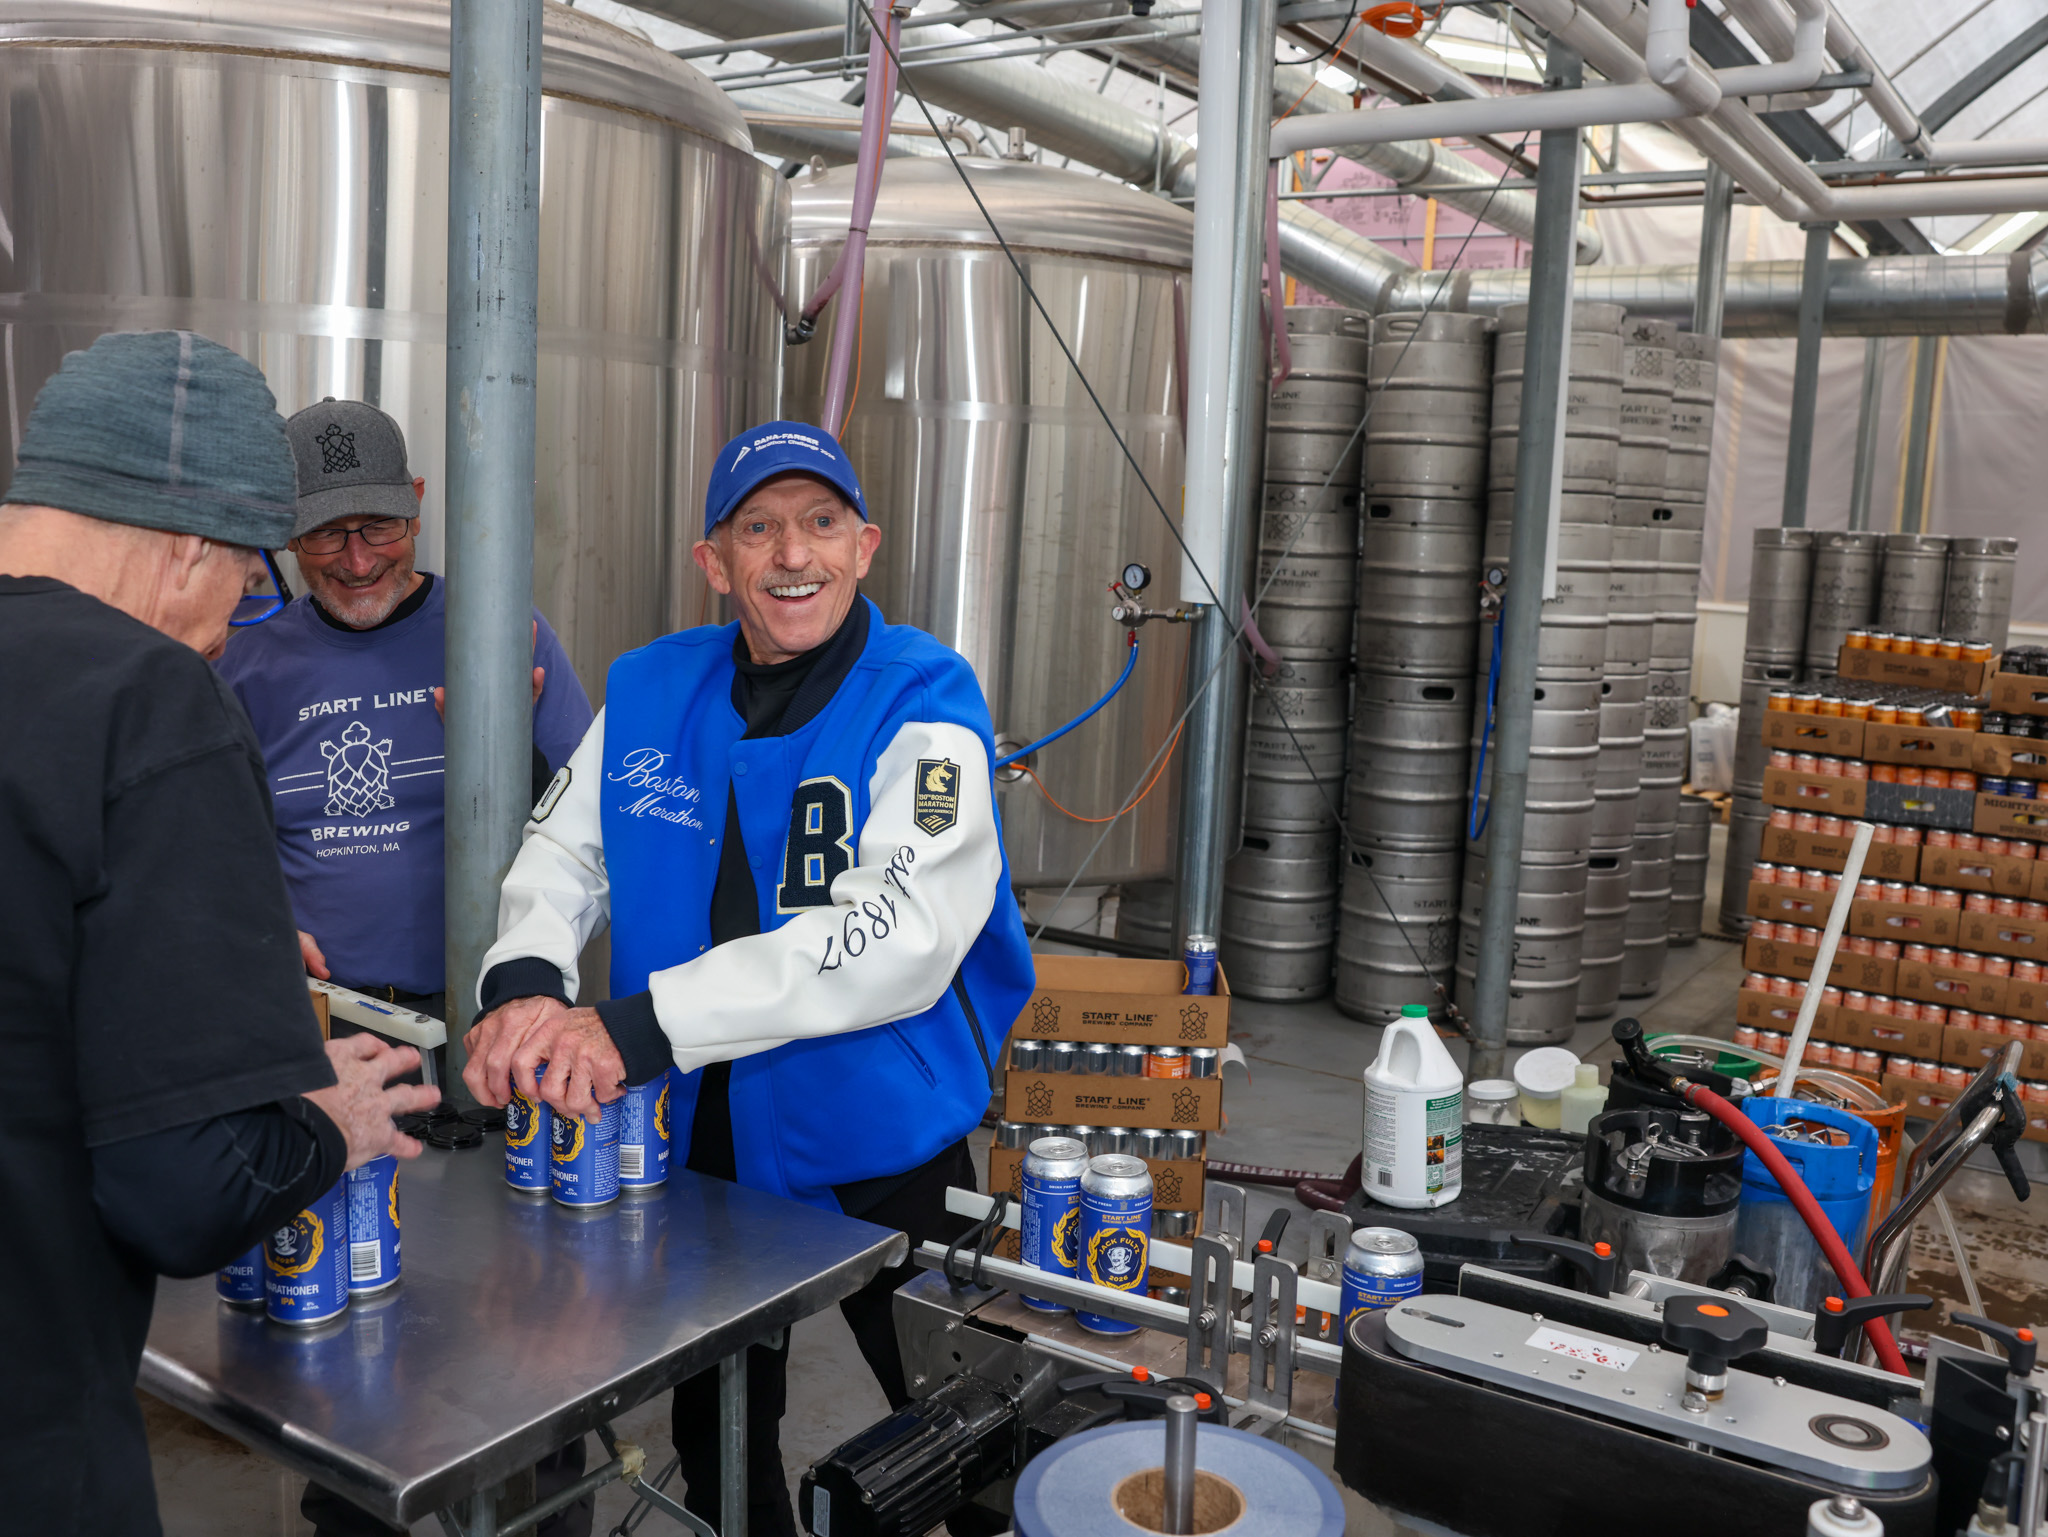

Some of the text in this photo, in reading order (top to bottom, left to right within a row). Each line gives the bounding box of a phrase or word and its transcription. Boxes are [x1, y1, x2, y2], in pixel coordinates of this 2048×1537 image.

[1620, 404, 1648, 414] TART
[754, 433, 819, 447] DANA-FARBER
[1260, 568, 1287, 577] TART
[298, 697, 362, 722] START
[608, 747, 701, 803] Boston
[918, 801, 954, 809] MARATHON
[1984, 798, 2029, 811] MIGHTY
[619, 792, 703, 831] Marathon
[311, 821, 410, 842] BREWING
[316, 842, 401, 859] HOPKINTON, MA
[776, 775, 854, 915] B
[818, 893, 898, 976] 1897
[1082, 1012, 1120, 1021] START
[1075, 1096, 1113, 1104] START
[508, 1164, 517, 1173] IPA
[553, 1179, 562, 1188] IPA
[1099, 1237, 1140, 1255] JACK FULTZ
[275, 1255, 296, 1264] 2026
[281, 1297, 296, 1306] IPA
[1358, 1291, 1382, 1301] START
